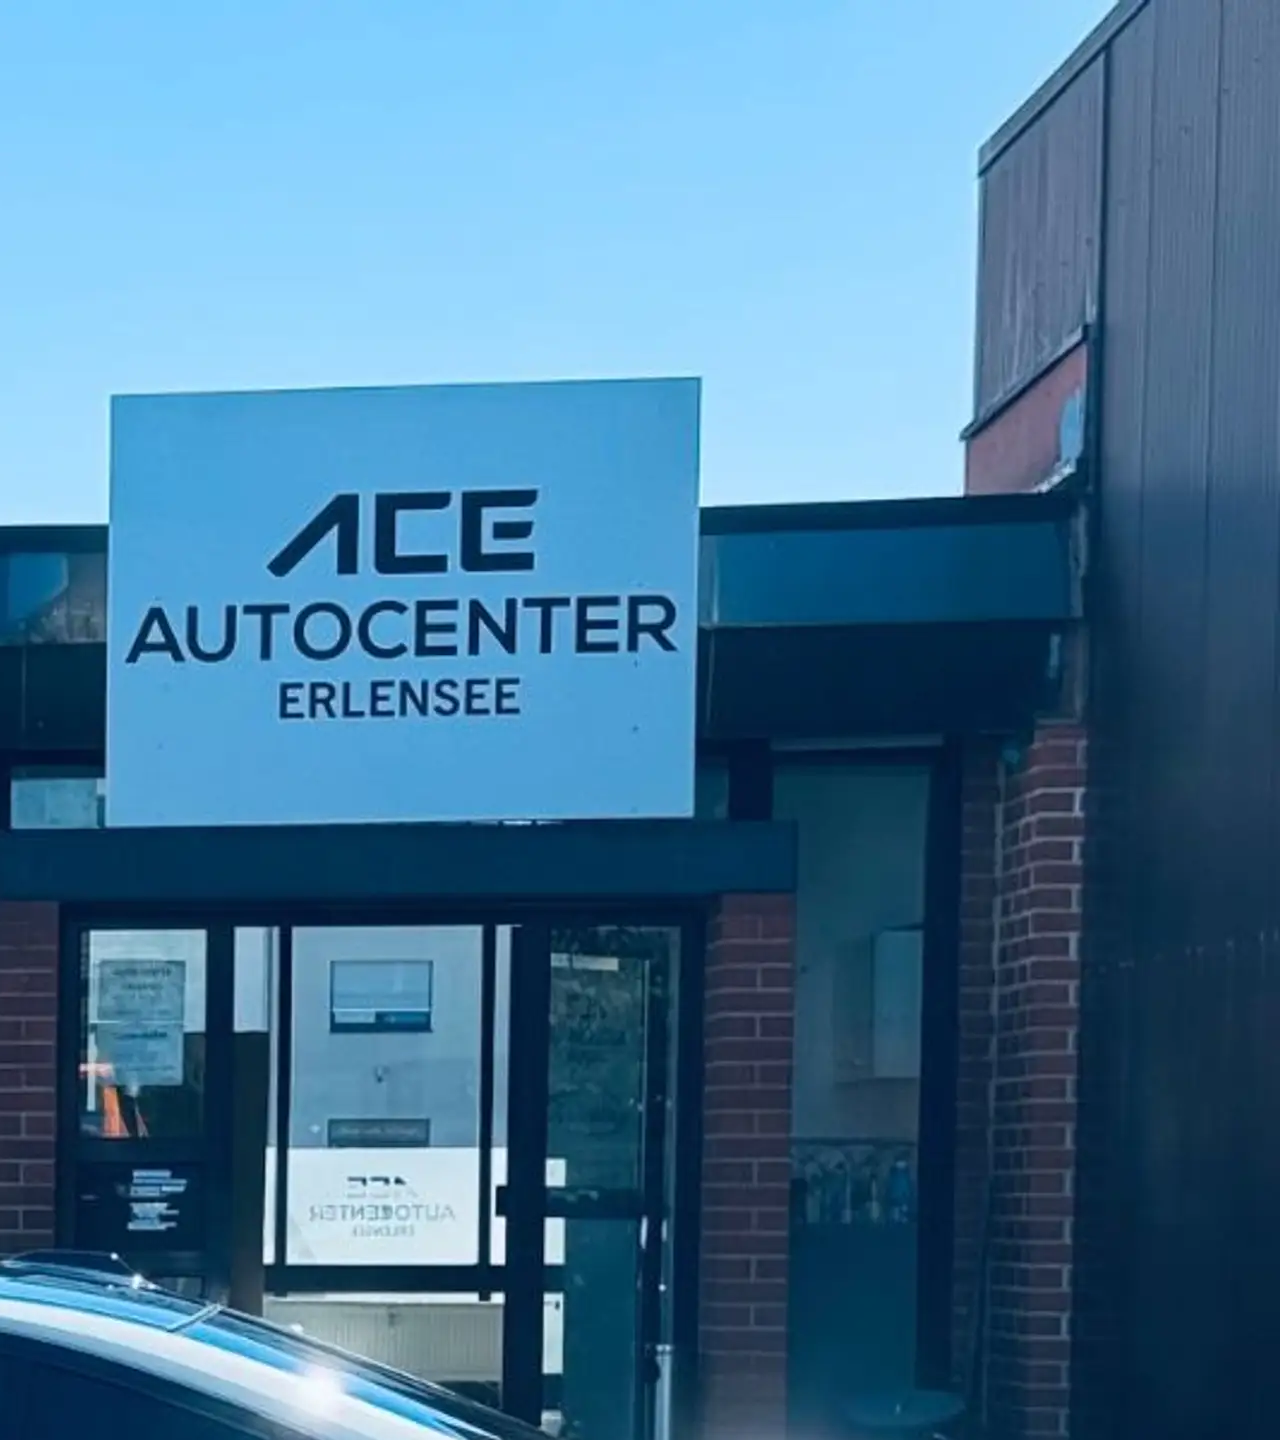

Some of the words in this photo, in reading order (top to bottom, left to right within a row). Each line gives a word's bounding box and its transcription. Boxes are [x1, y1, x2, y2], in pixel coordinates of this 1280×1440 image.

[266, 488, 540, 578] ACE
[124, 594, 679, 664] AUTOCENTER
[278, 676, 522, 720] ERLENSEE
